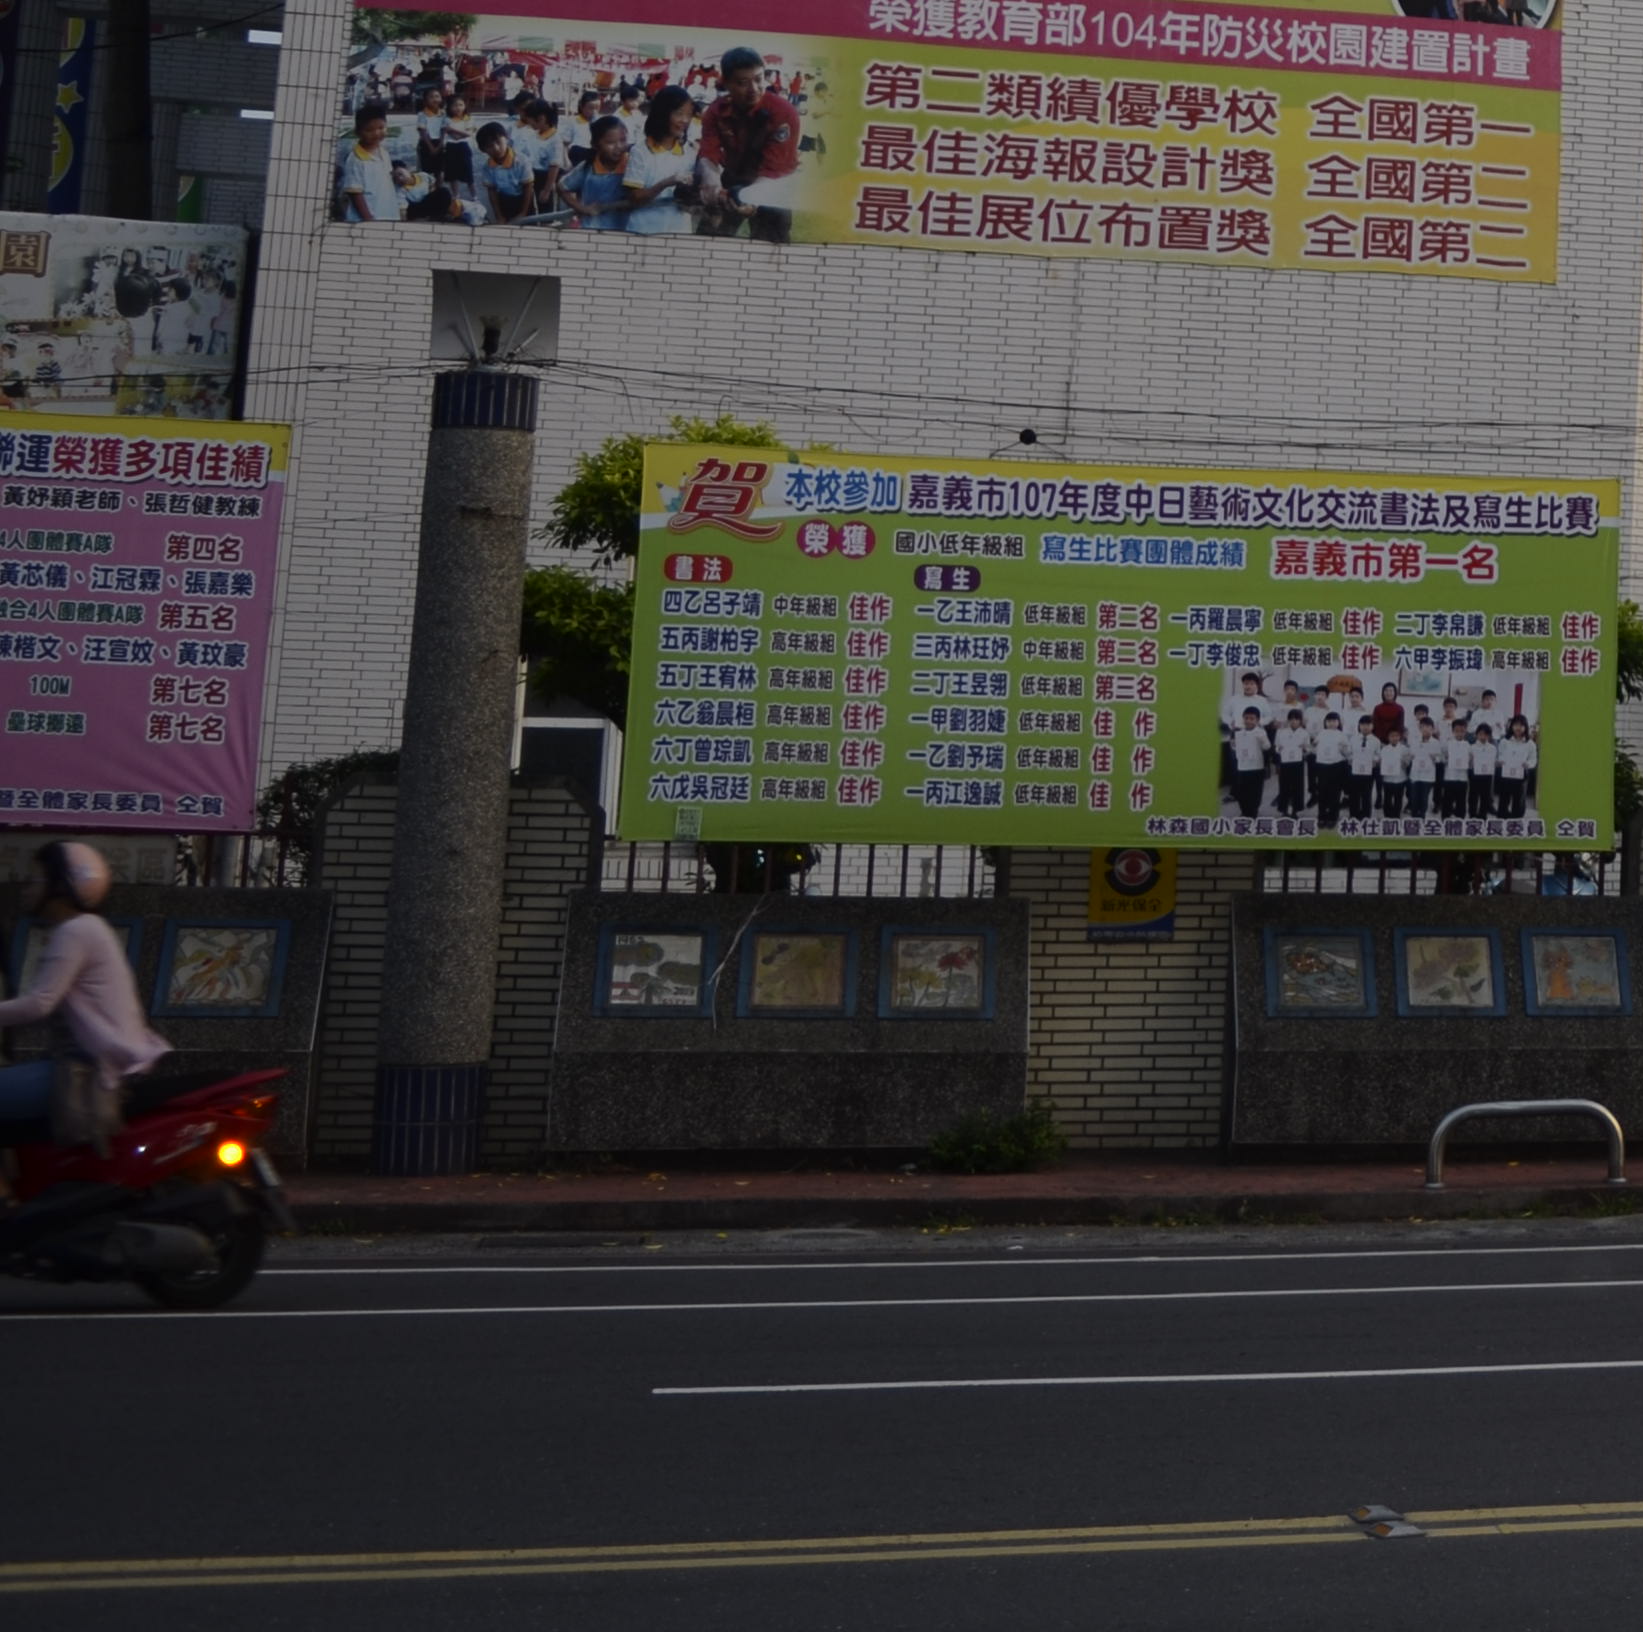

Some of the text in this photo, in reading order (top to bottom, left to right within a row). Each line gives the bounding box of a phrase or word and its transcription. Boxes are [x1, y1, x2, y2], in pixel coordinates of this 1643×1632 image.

[864, 62, 1532, 147] 第二類績優學校 全國第一
[860, 125, 1527, 210] 最佳海報設計獎 全國第二
[856, 187, 1526, 270] 最佳展位布置獎 全國第二
[0, 228, 51, 278] 園
[668, 457, 1596, 539] 賀 本校參加 嘉義市107年度中日藝術文化交流書法及寫生比賽
[167, 535, 242, 563] 第四名
[803, 523, 1498, 580] 榮獲 國小低年級組 寫生比賽團體成績 嘉義市第一名
[674, 557, 971, 590] 書法 寫生
[159, 603, 235, 632] 第五名
[664, 590, 762, 617] 四乙呂子靖
[773, 596, 838, 618] 中年級組
[849, 595, 891, 621] 佳作
[917, 599, 1011, 626] 一乙王沛晴
[1024, 605, 1086, 626] 低年級組
[1098, 604, 1158, 631] 第二名
[1273, 612, 1333, 634] 低年級組
[1342, 610, 1382, 637] 佳作
[1492, 615, 1551, 637] 低年級組
[1562, 613, 1600, 640] 佳作
[661, 626, 759, 653] 五丙謝柏宇
[771, 631, 835, 654] 高年級組
[847, 631, 889, 658] 佳作
[1022, 641, 1084, 662] 中年級組
[1097, 640, 1157, 667] 第二名
[1272, 647, 1332, 669] 低年級組
[1341, 644, 1381, 672] 佳作
[1491, 650, 1550, 672] 高年級組
[1561, 647, 1600, 675] 佳作
[30, 675, 228, 706] 100M 第七名
[769, 669, 834, 690] 高年級組
[845, 668, 887, 695] 佳作
[1021, 677, 1083, 698] 低年級組
[1095, 675, 1156, 702] 第三名
[148, 715, 225, 744] 第七名
[767, 706, 831, 726] 高年級組
[843, 704, 885, 732] 佳作
[1020, 713, 1081, 734] 低年級組
[764, 742, 828, 763] 高年級組
[841, 741, 883, 769] 佳作
[1017, 749, 1079, 770] 低年級組
[177, 795, 223, 817] 仝賀
[762, 779, 826, 800] 高年級組
[838, 777, 880, 805] 佳作
[1015, 785, 1077, 806] 低年級組
[1146, 817, 1317, 838] 林森國小家長會長
[1557, 820, 1597, 839] 仝賀
